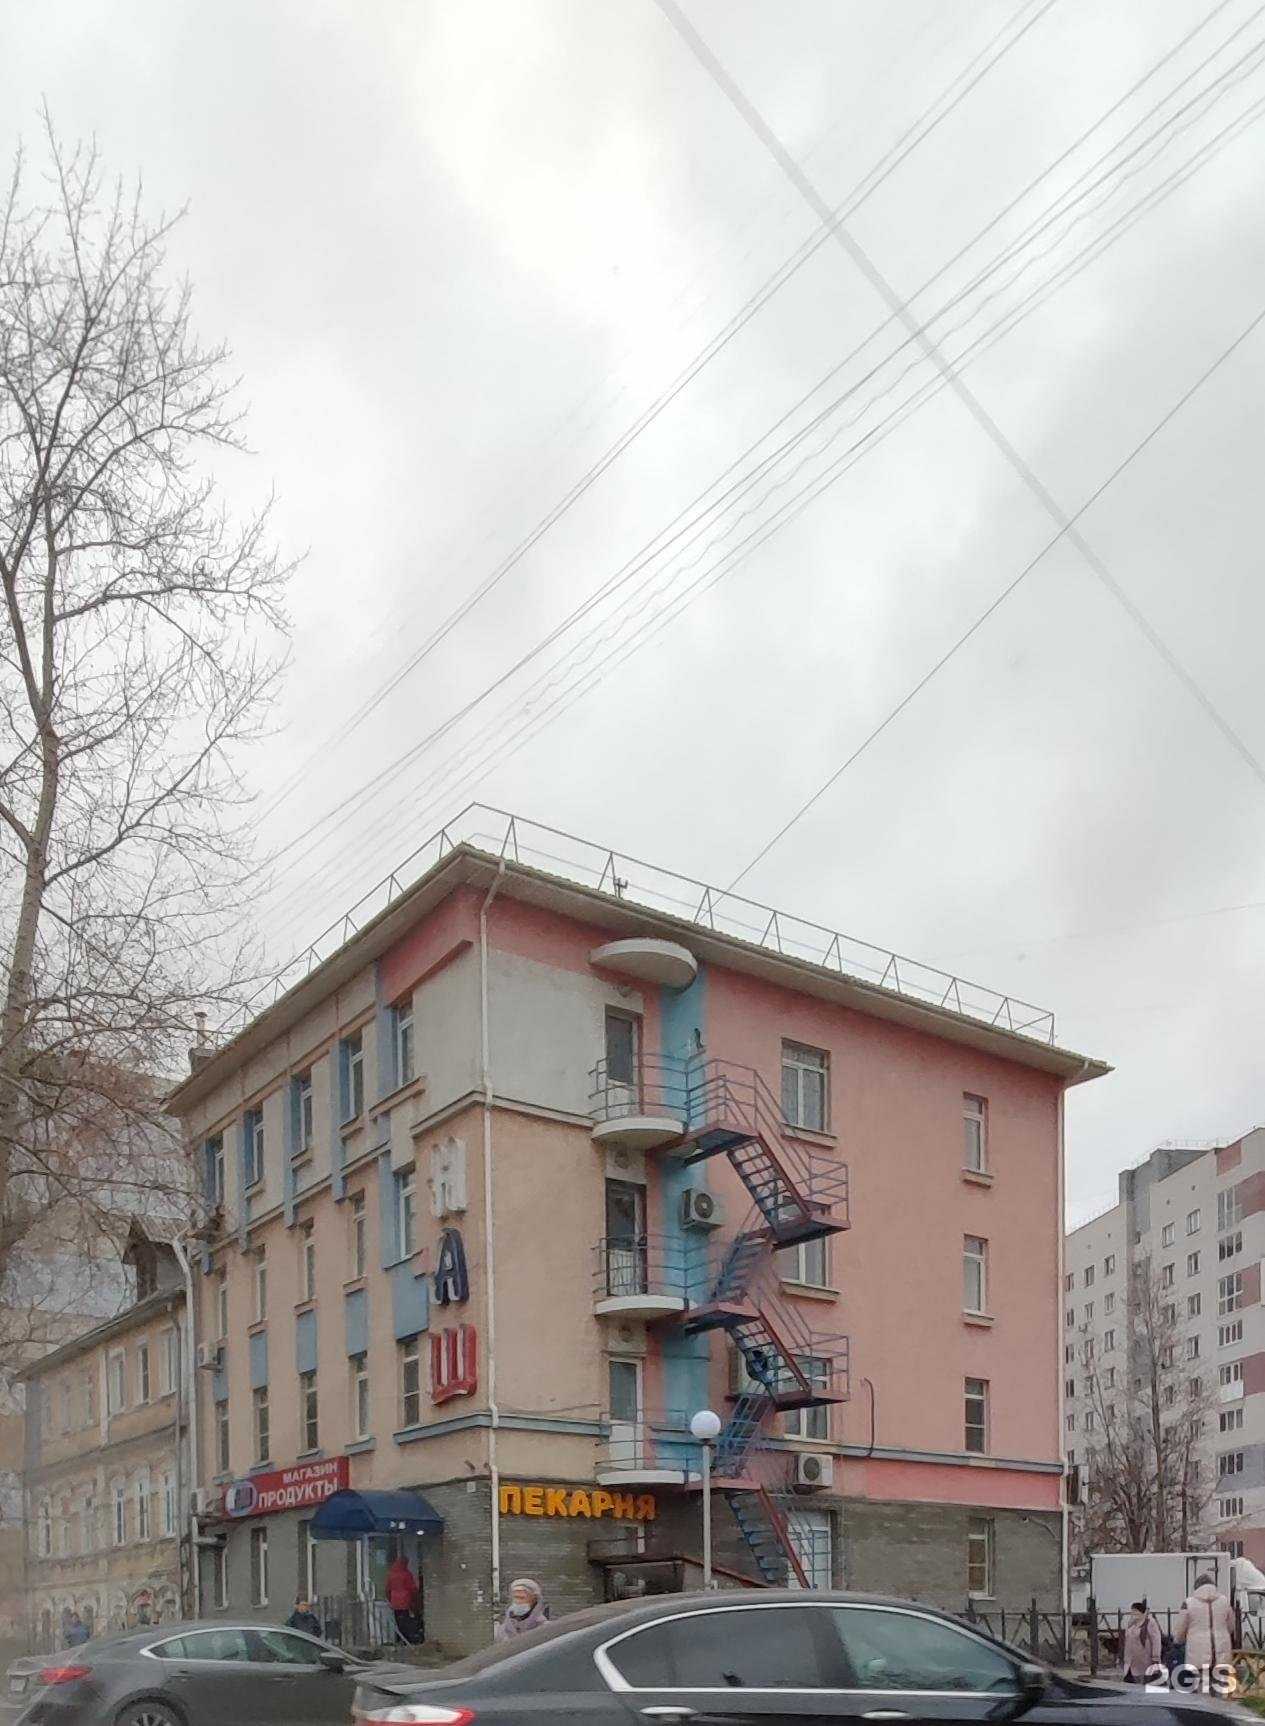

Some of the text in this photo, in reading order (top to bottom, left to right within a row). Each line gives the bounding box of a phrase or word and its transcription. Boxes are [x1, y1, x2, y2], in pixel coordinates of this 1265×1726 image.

[282, 1461, 338, 1484] МАГАЗИН
[258, 1478, 338, 1508] ПРОДУКТЫ
[500, 1485, 656, 1520] ПЕКАРНЯ
